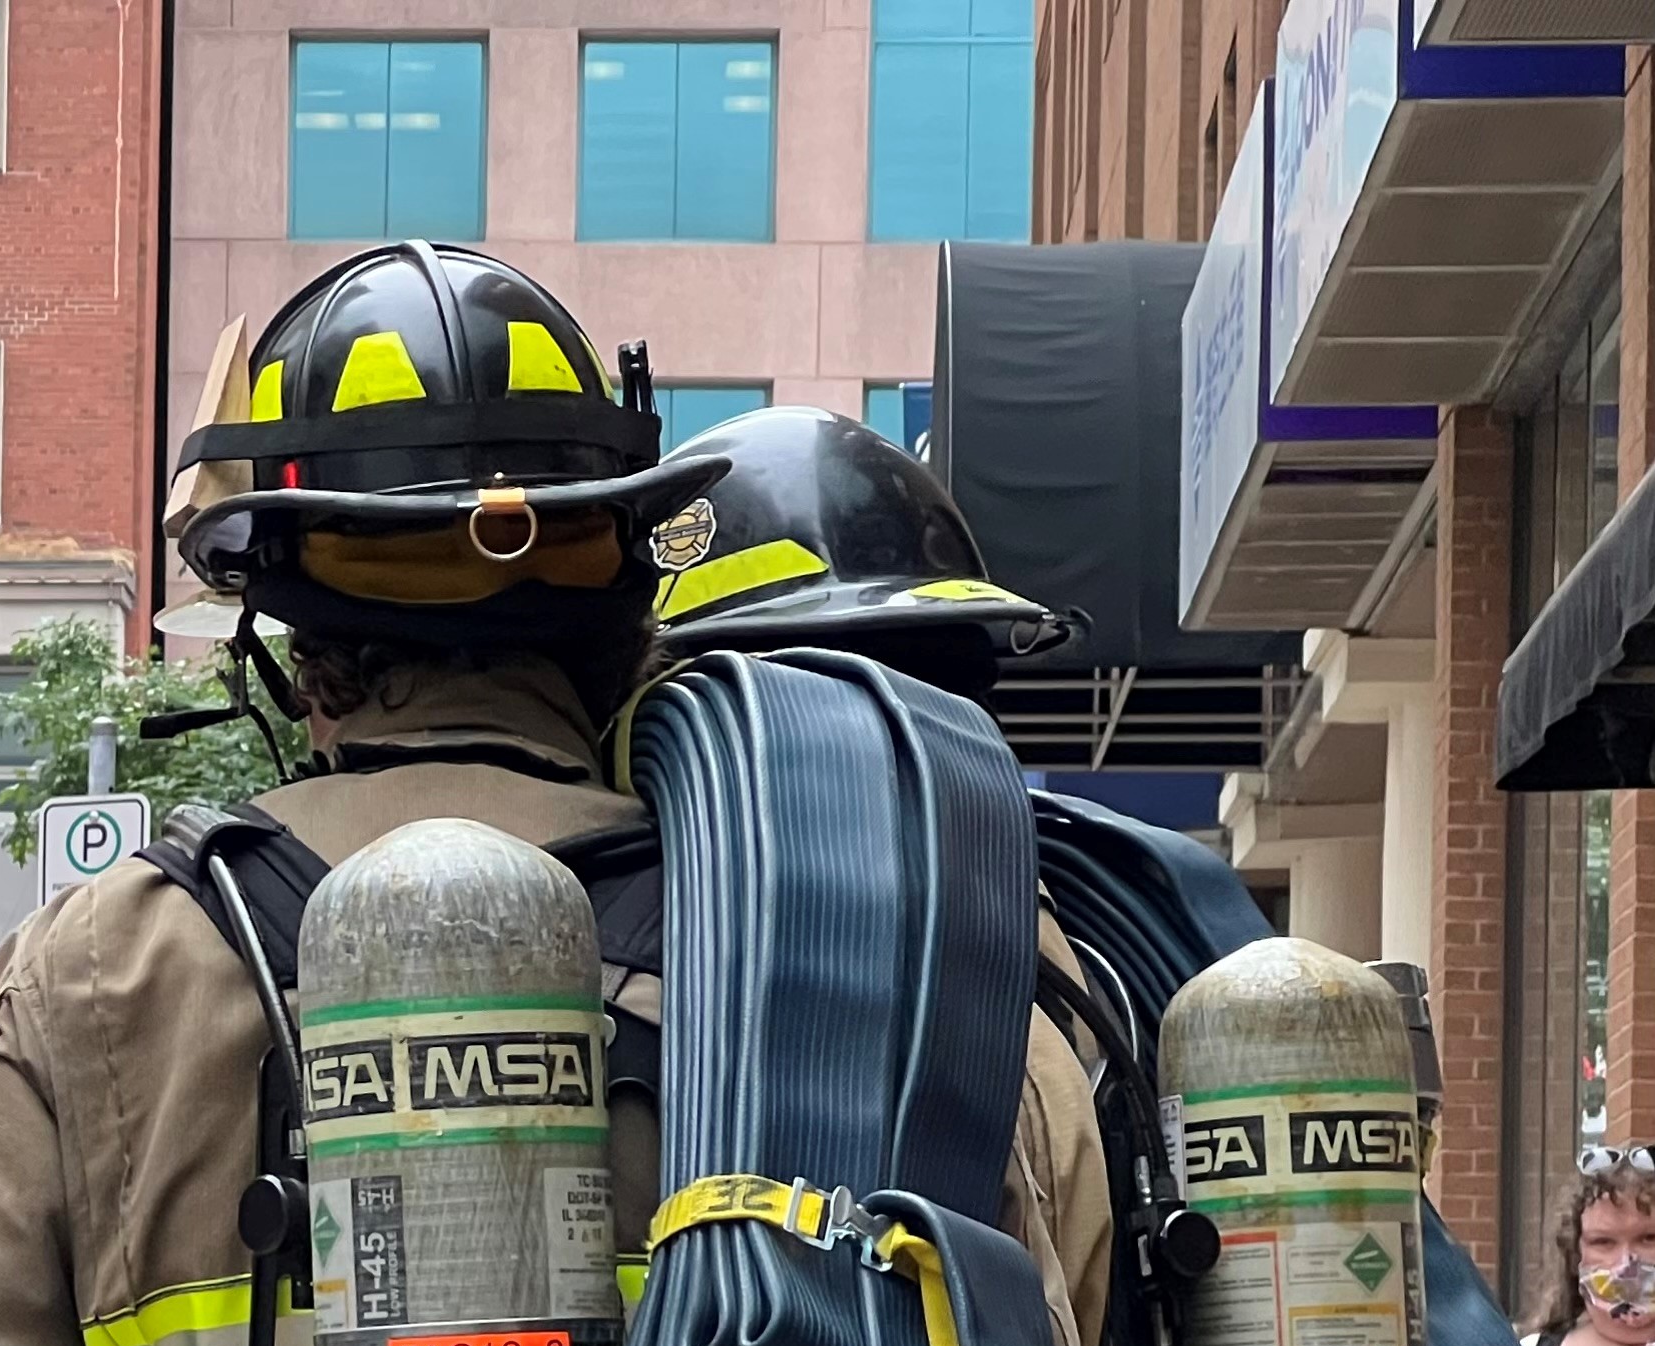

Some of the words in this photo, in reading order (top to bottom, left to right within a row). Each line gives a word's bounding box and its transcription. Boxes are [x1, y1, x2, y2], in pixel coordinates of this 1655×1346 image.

[83, 823, 107, 863] P
[304, 1052, 389, 1111] SA
[424, 1044, 588, 1100] MSA
[1303, 1119, 1417, 1165] MSA
[359, 1231, 390, 1320] H-45
